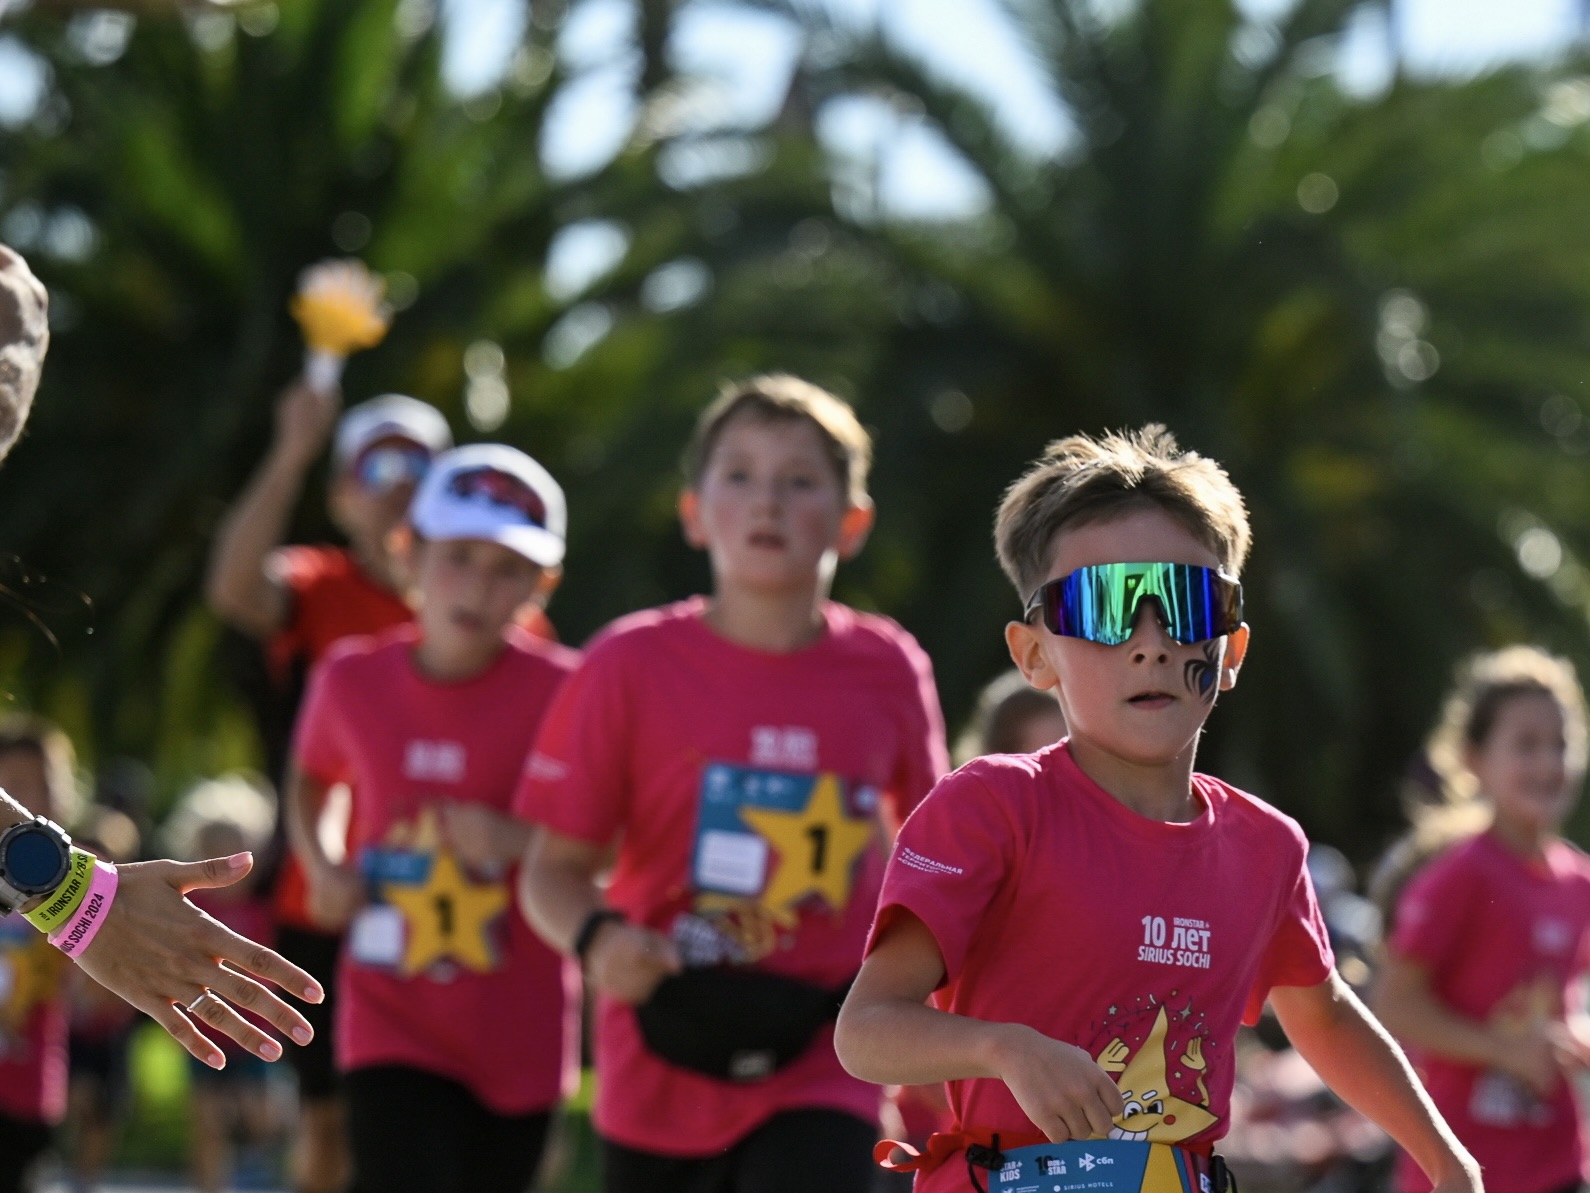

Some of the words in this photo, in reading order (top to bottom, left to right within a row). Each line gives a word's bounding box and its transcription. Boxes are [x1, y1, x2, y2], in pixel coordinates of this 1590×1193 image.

[807, 825, 828, 874] 1
[47, 879, 81, 917] IRONSTAR
[76, 862, 87, 878] 1/8
[68, 917, 93, 944] SOCHI
[85, 893, 104, 919] 2024
[435, 894, 455, 937] 1
[1141, 915, 1166, 947] 10
[1138, 946, 1174, 965] SIRIUS
[1176, 950, 1210, 969] SOCHI
[1000, 1169, 1021, 1182] KIDS
[1047, 1166, 1067, 1176] STAR
